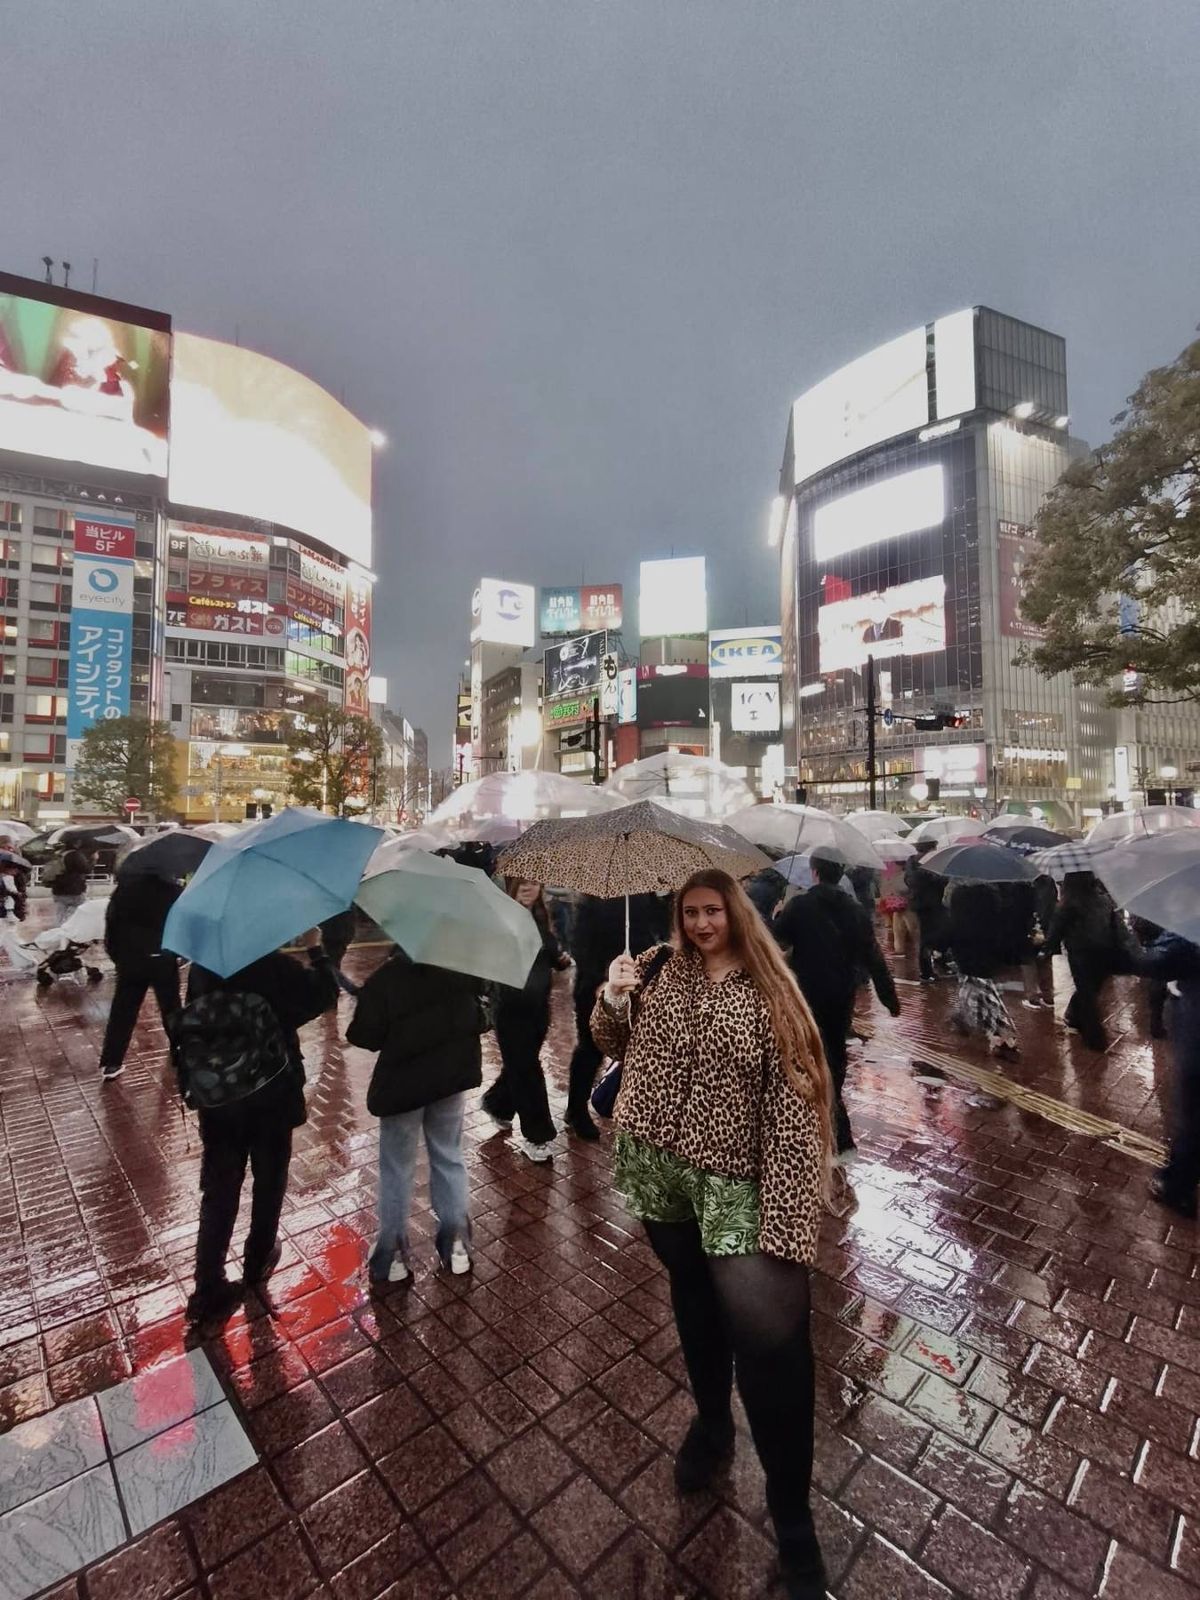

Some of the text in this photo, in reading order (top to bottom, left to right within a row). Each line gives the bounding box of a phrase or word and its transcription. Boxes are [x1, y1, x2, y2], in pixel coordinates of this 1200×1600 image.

[85, 525, 125, 541] 当ビル
[95, 540, 116, 552] 5F
[170, 540, 186, 549] 9F
[79, 593, 126, 606] eyecity
[167, 610, 187, 622] 7F
[213, 614, 260, 633] ガスト
[719, 645, 776, 658] IKEA
[76, 625, 104, 719] アイシティ
[104, 628, 124, 720] コンタクトの
